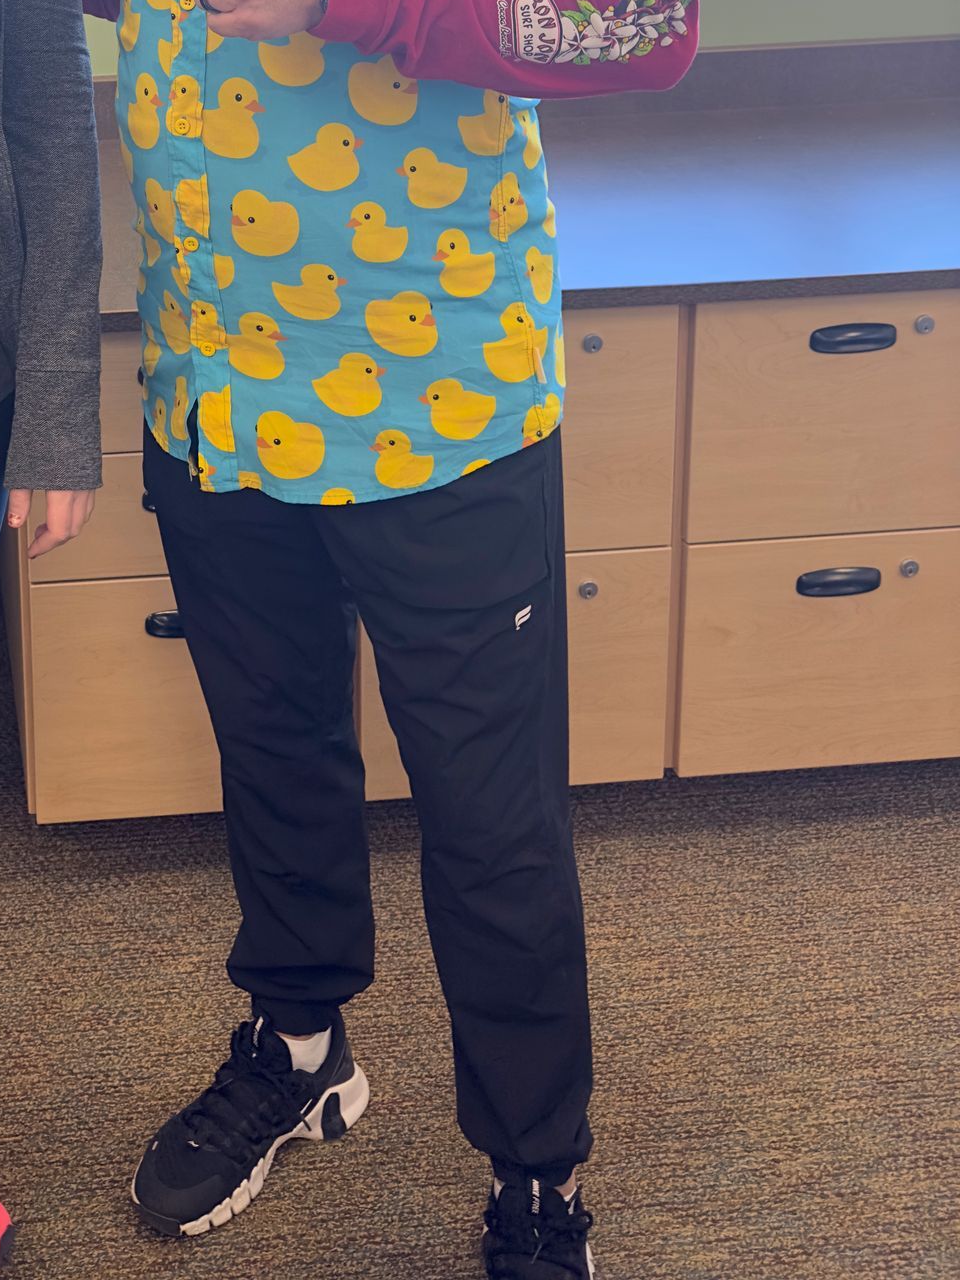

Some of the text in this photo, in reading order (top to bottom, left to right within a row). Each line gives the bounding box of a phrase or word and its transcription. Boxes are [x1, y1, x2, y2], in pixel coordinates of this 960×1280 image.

[520, 4, 534, 57] SURF SHOP
[533, 32, 556, 62] JON
